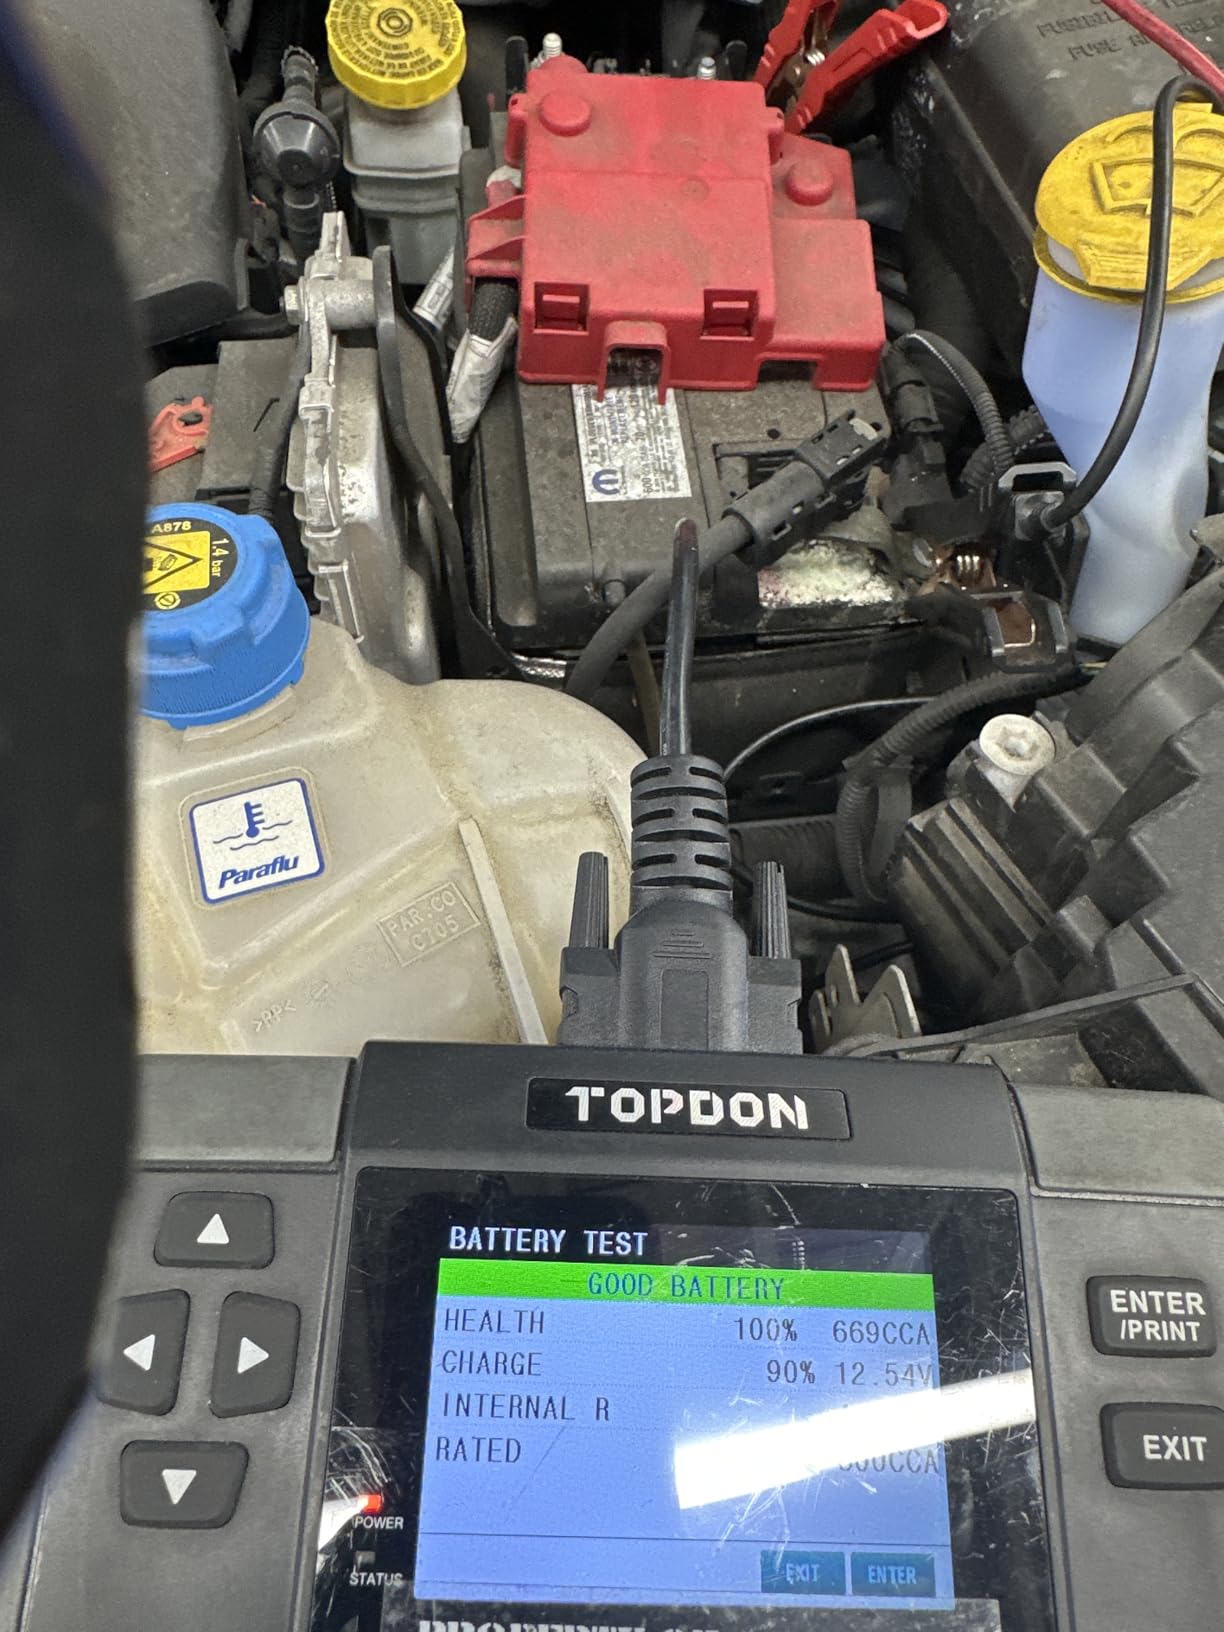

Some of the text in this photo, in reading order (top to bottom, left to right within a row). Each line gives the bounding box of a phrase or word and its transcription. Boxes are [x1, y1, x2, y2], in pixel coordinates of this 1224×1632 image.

[1068, 39, 1122, 60] FUSE
[212, 538, 229, 577] 1.4 bar
[219, 855, 300, 889] Paraflu
[564, 1086, 809, 1130] TOPDON
[449, 1226, 649, 1256] BATTERY TEST
[588, 1272, 783, 1301] GOOD BATTERY
[1110, 1289, 1206, 1316] ENTER
[444, 1308, 931, 1346] HEALTH 100% 669CCA
[1120, 1319, 1200, 1342] /PRINT
[441, 1350, 542, 1376] CHARGE
[766, 1359, 816, 1385] 90%
[443, 1392, 610, 1422] INTERNAL R
[435, 1436, 522, 1463] RATED
[1142, 1435, 1207, 1462] EXIT
[354, 1516, 404, 1530] POWER
[349, 1573, 404, 1587] STATUS
[785, 1563, 916, 1585] EXIT ENTER
